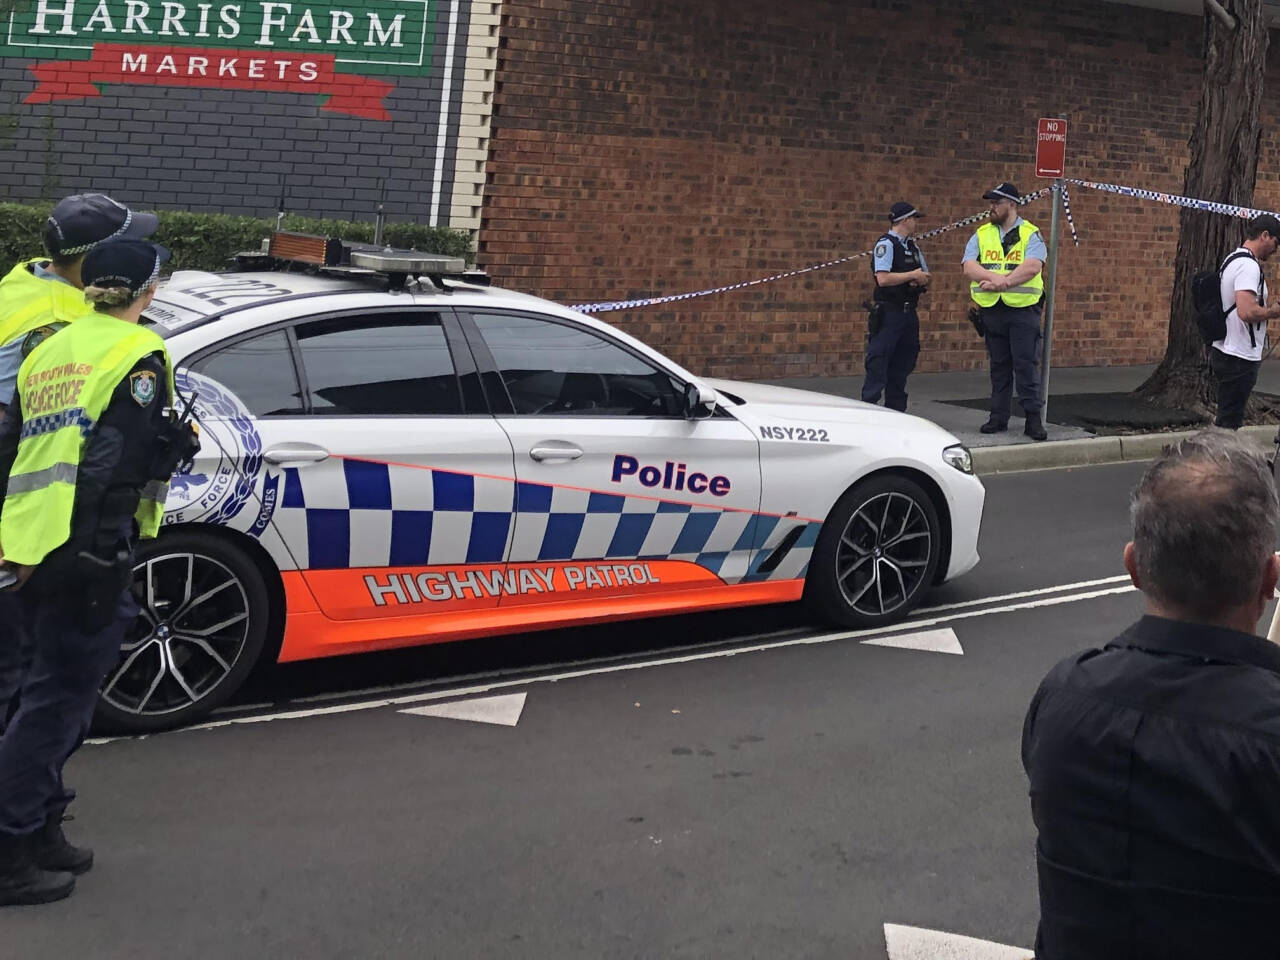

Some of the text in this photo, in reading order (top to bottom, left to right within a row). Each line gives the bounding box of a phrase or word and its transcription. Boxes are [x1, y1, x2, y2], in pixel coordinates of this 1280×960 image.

[254, 1, 406, 48] FARM
[121, 52, 319, 82] MARKETS
[1039, 132, 1065, 142] STOPPING
[1047, 122, 1058, 132] NO
[760, 426, 830, 442] NSY222
[200, 466, 232, 510] FORCE
[611, 454, 731, 497] Police
[256, 488, 276, 529] COMES
[363, 562, 660, 607] HIGHWAY PATROL
